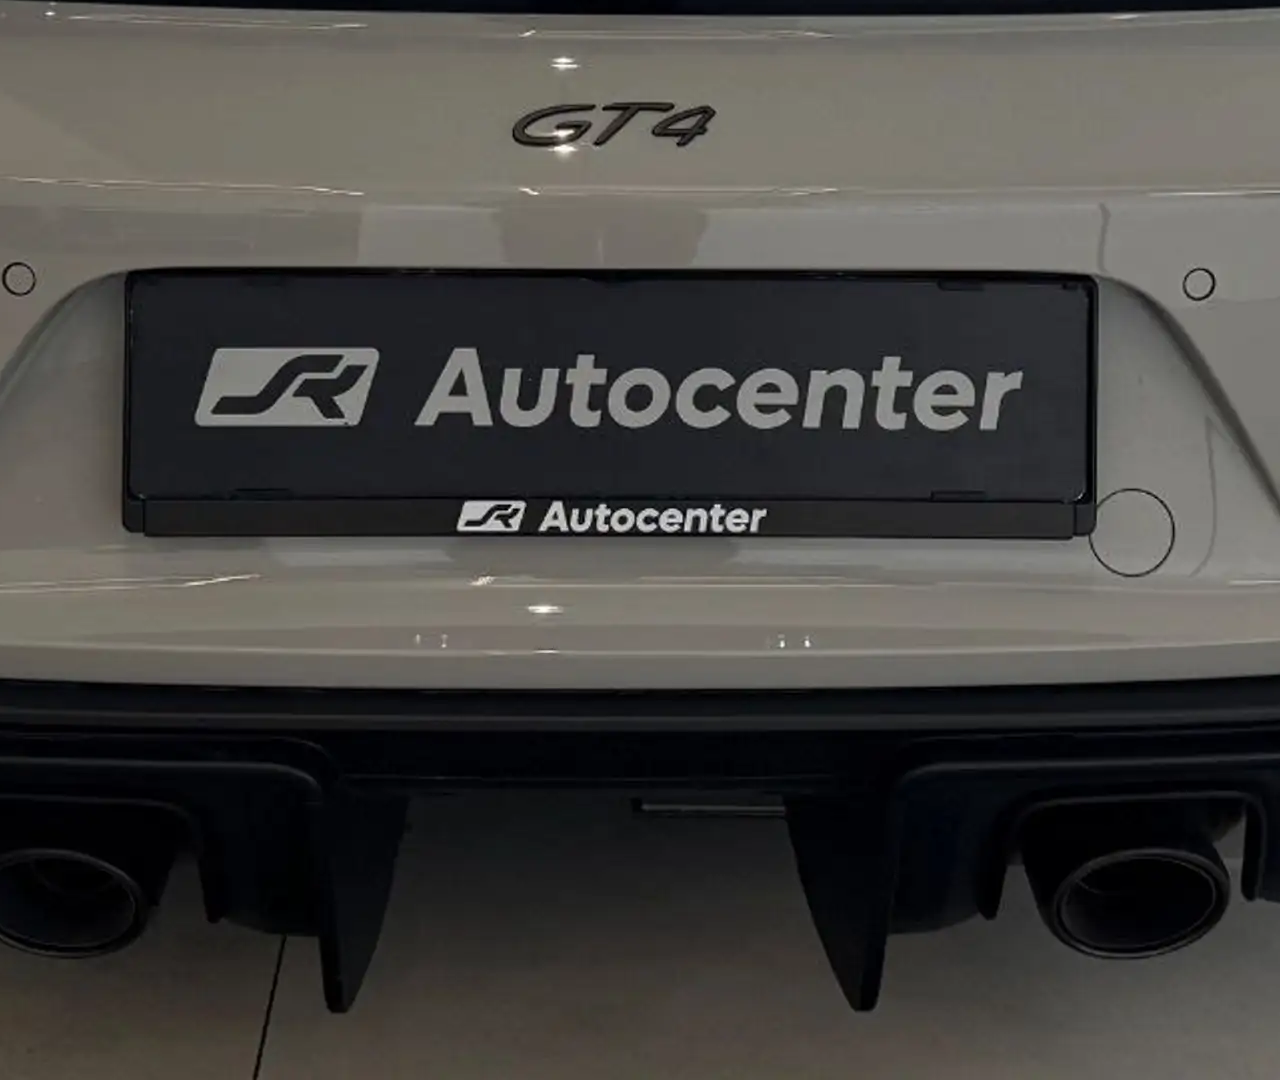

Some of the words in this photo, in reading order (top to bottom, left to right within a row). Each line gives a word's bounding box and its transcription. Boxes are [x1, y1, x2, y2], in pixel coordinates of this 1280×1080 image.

[512, 102, 717, 147] GT4
[415, 348, 1023, 431] Autocenter
[539, 501, 767, 532] Autocenter
